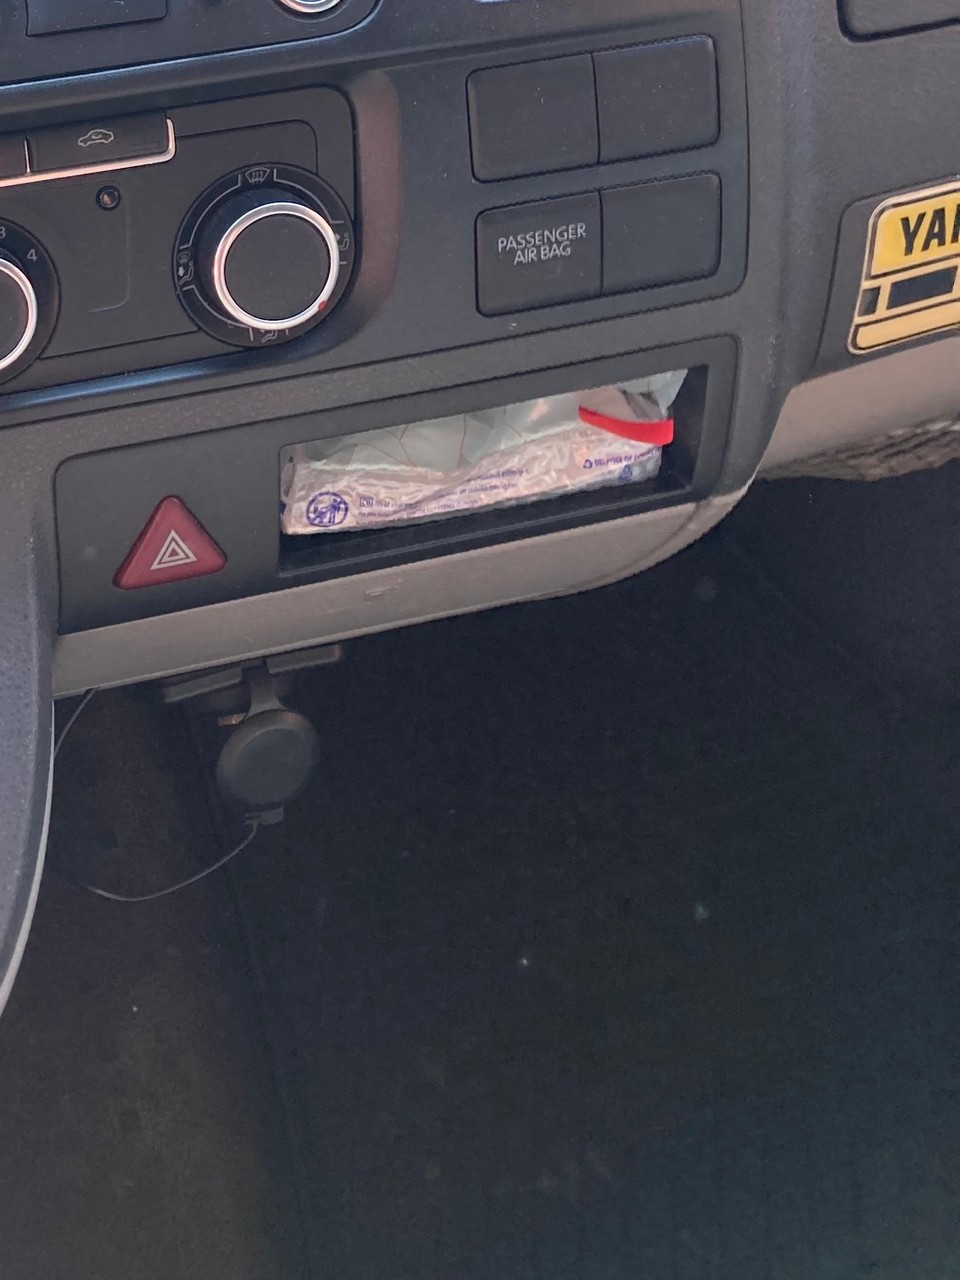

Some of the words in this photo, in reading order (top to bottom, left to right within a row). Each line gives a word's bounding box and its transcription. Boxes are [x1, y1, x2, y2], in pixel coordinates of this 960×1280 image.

[498, 222, 587, 253] PASSENGER
[26, 249, 39, 263] 4
[513, 247, 538, 266] AIR
[540, 240, 572, 261] BAG
